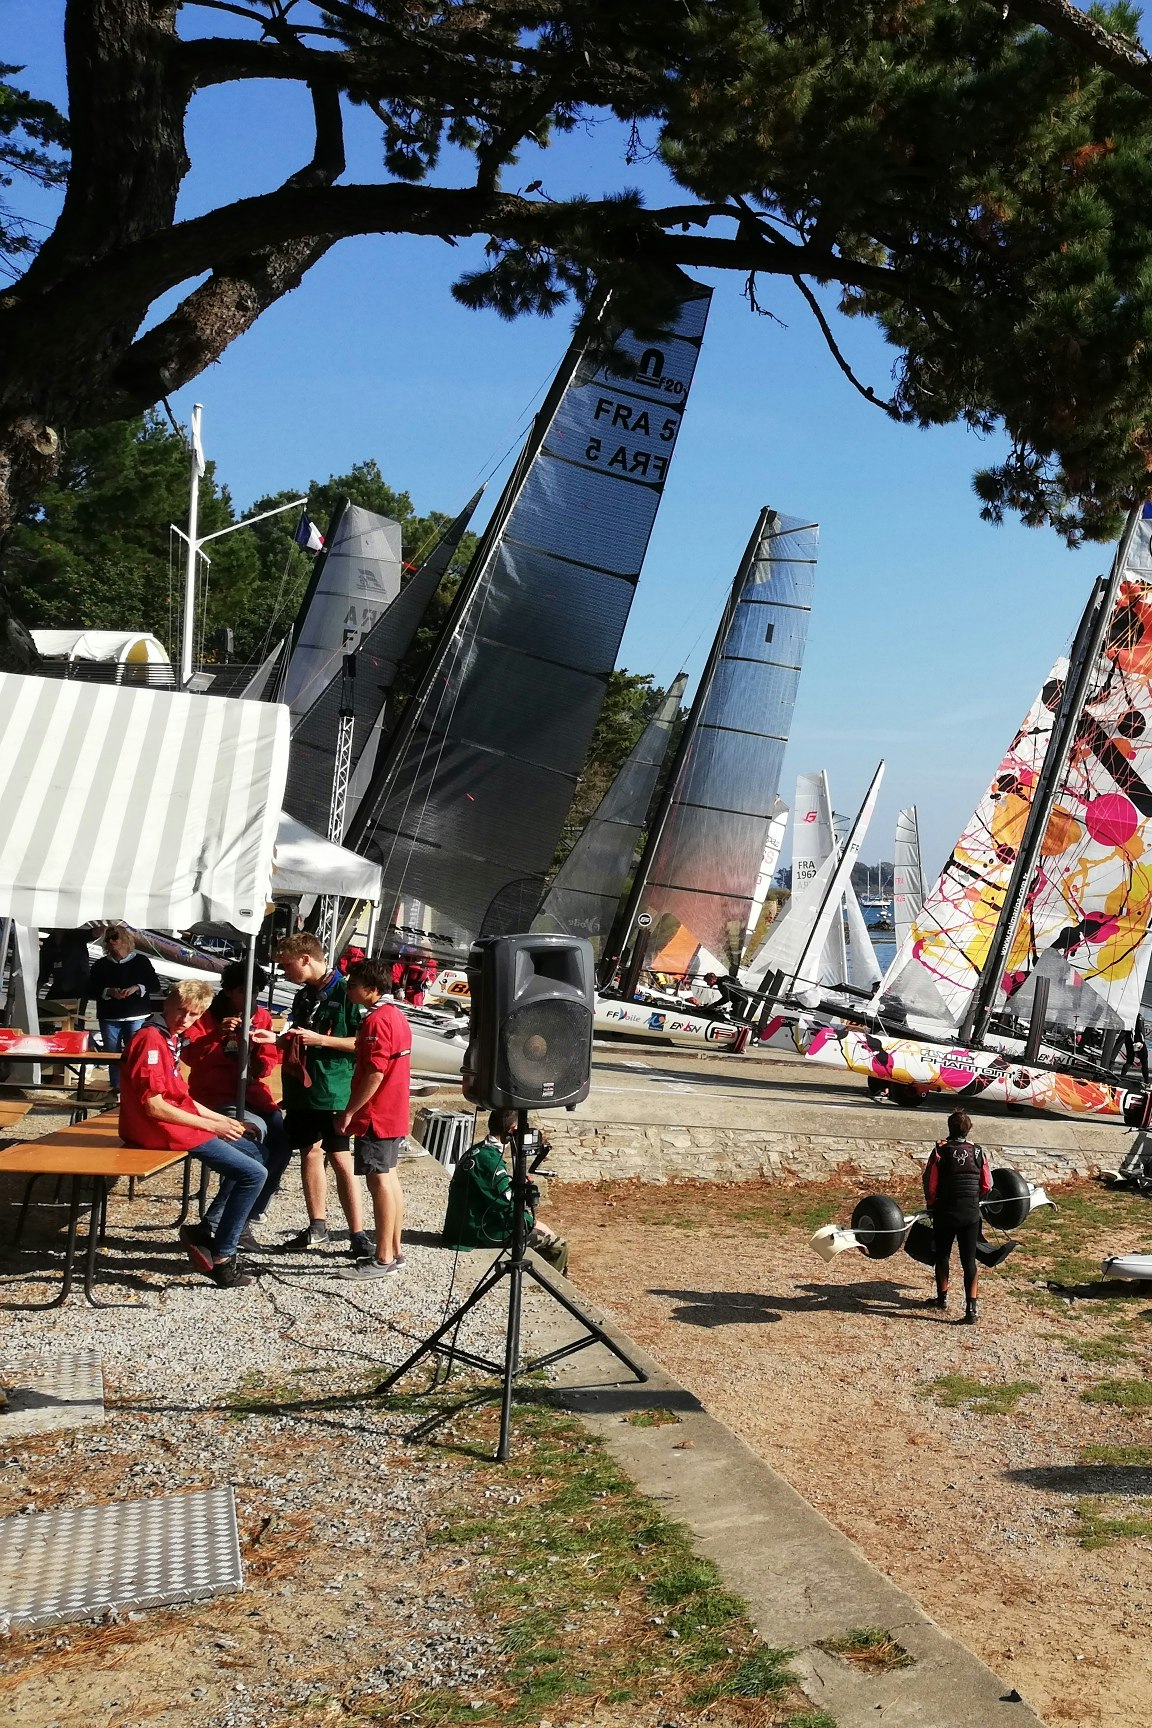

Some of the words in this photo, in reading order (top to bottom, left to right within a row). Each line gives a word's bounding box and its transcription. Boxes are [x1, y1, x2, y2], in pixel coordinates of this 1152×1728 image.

[594, 398, 650, 437] FRA
[659, 419, 678, 441] 5
[798, 860, 815, 869] FRA
